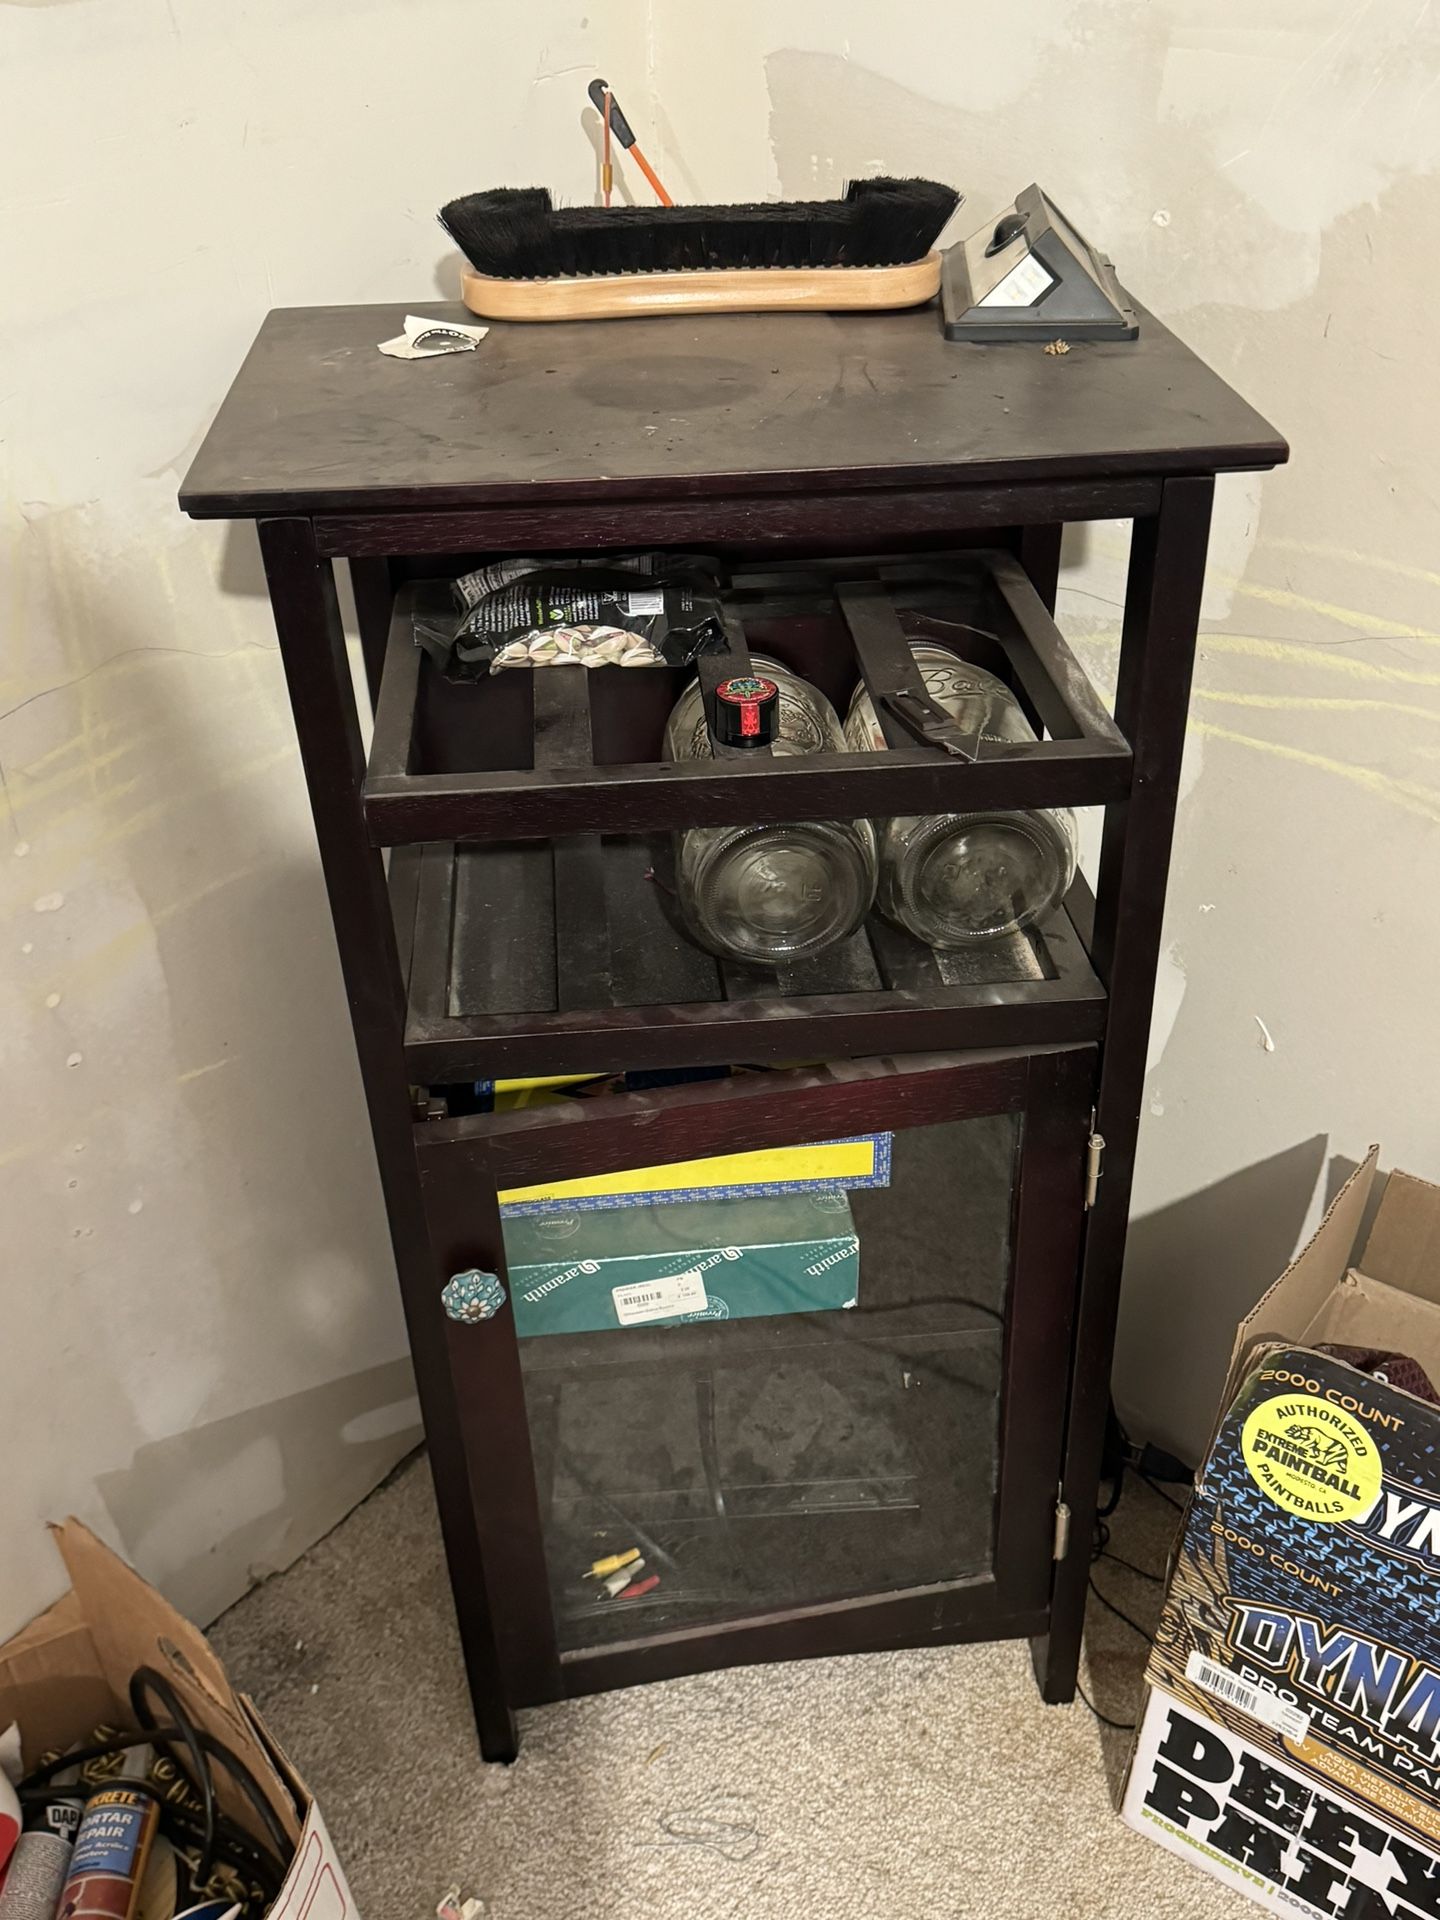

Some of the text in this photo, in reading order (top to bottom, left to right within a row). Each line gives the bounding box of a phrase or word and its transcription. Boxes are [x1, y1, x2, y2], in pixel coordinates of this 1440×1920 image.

[522, 1270, 580, 1302] aramith
[1259, 1369, 1405, 1432] 2000 COUNT
[1256, 1428, 1310, 1459] EXTREME
[1276, 1404, 1368, 1457] AUTHORIZED
[1251, 1438, 1361, 1501] PAINTBALL
[1257, 1463, 1344, 1514] PAINTBALLS
[1210, 1521, 1343, 1597] 2000 COUNT
[1240, 1664, 1299, 1706] PRO
[1307, 1702, 1384, 1759] TEAM
[1310, 1758, 1377, 1800] ADVANTAGE
[1319, 1754, 1356, 1779] ULTRA
[1360, 1778, 1410, 1808] VIOLENT
[1325, 1752, 1358, 1774] AQUA
[1360, 1772, 1417, 1808] METALLIC
[52, 1808, 79, 1825] DAP
[1140, 1807, 1266, 1888] PROGRESSIVE
